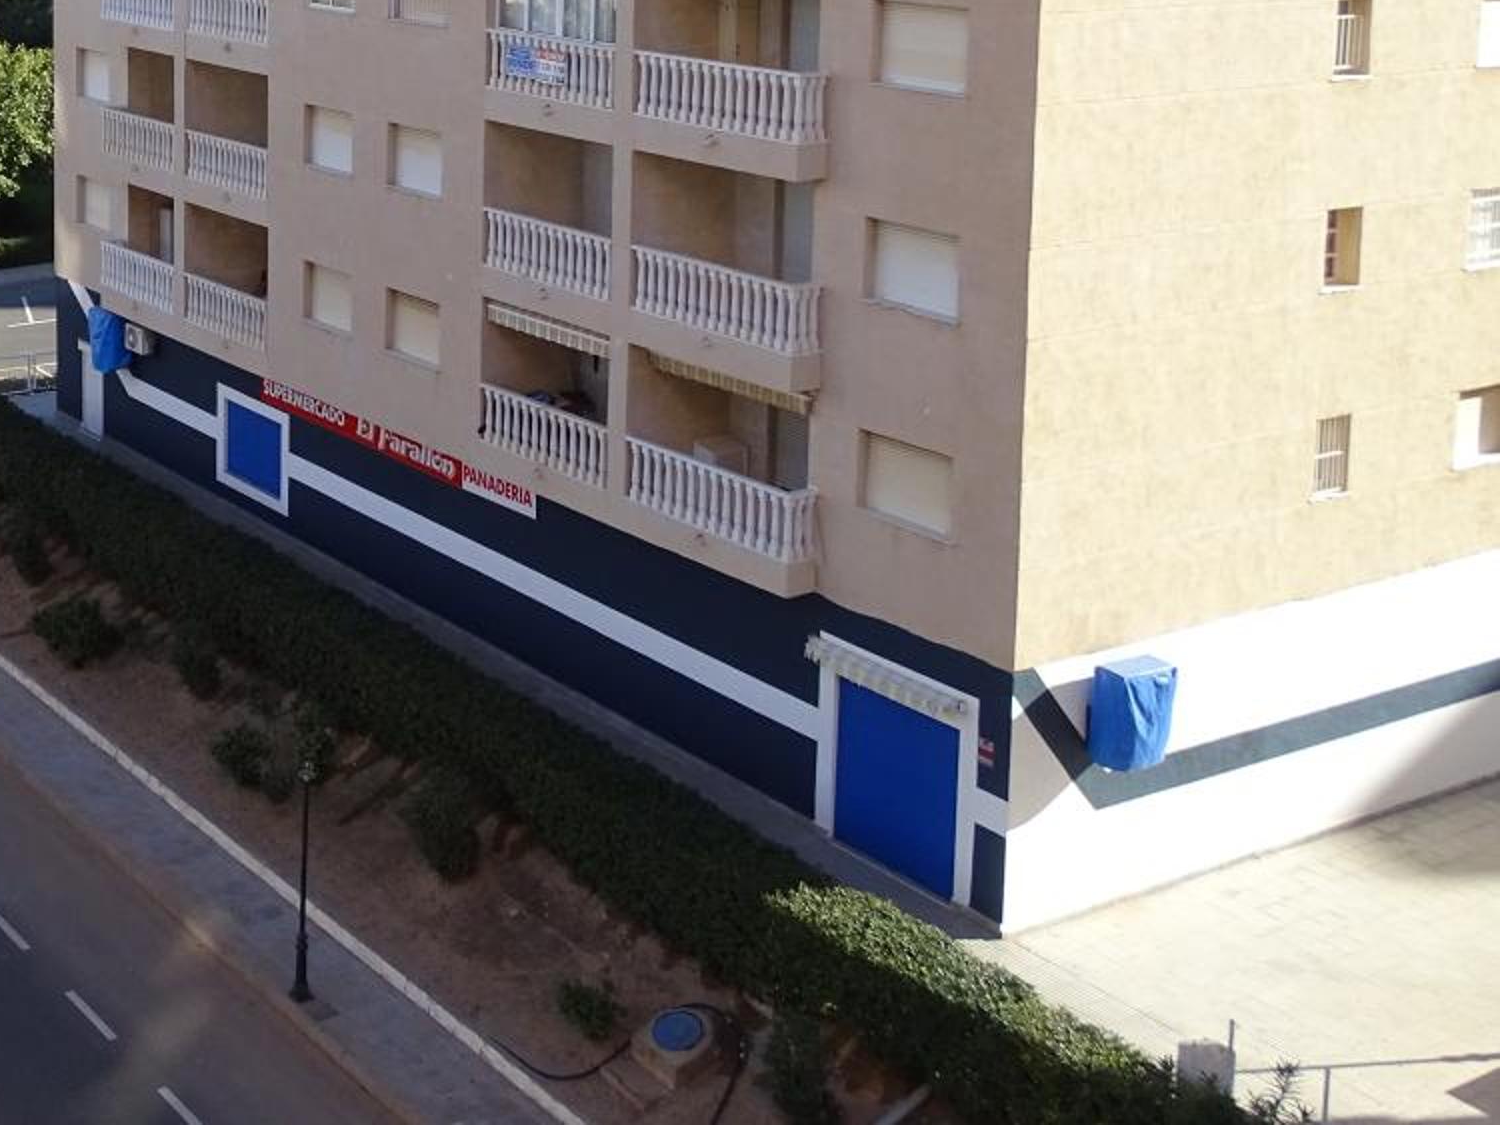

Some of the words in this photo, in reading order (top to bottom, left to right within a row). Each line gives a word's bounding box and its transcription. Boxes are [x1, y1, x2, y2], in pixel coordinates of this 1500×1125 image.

[262, 378, 345, 426] SUPERMERCADO
[356, 416, 374, 441] El
[463, 464, 533, 508] PANADERIA
